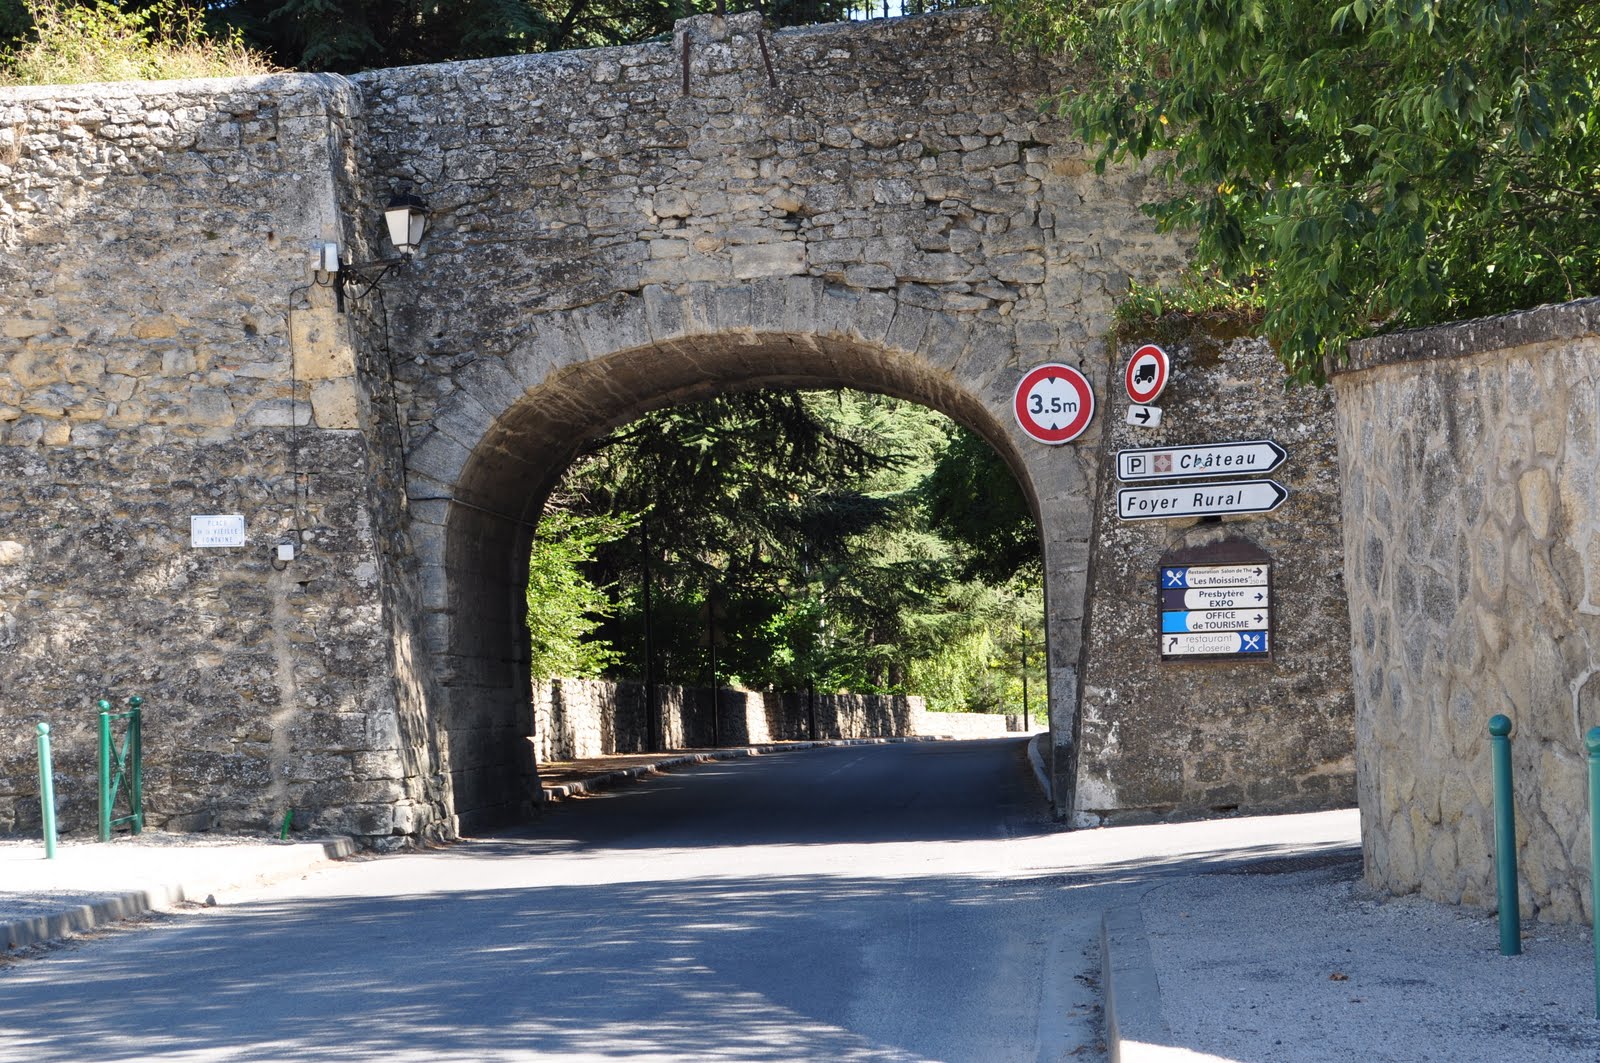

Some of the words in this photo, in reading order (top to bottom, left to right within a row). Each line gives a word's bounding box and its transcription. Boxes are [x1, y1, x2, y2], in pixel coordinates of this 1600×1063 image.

[1030, 394, 1077, 414] 3.5m
[1180, 453, 1255, 469] Château
[1127, 497, 1178, 512] Foyer
[1193, 490, 1242, 507] Rural
[1198, 590, 1244, 599] Presbytère
[1206, 612, 1236, 620] OFFICE
[1205, 620, 1249, 629] TOURISME
[1186, 634, 1232, 642] restaurant
